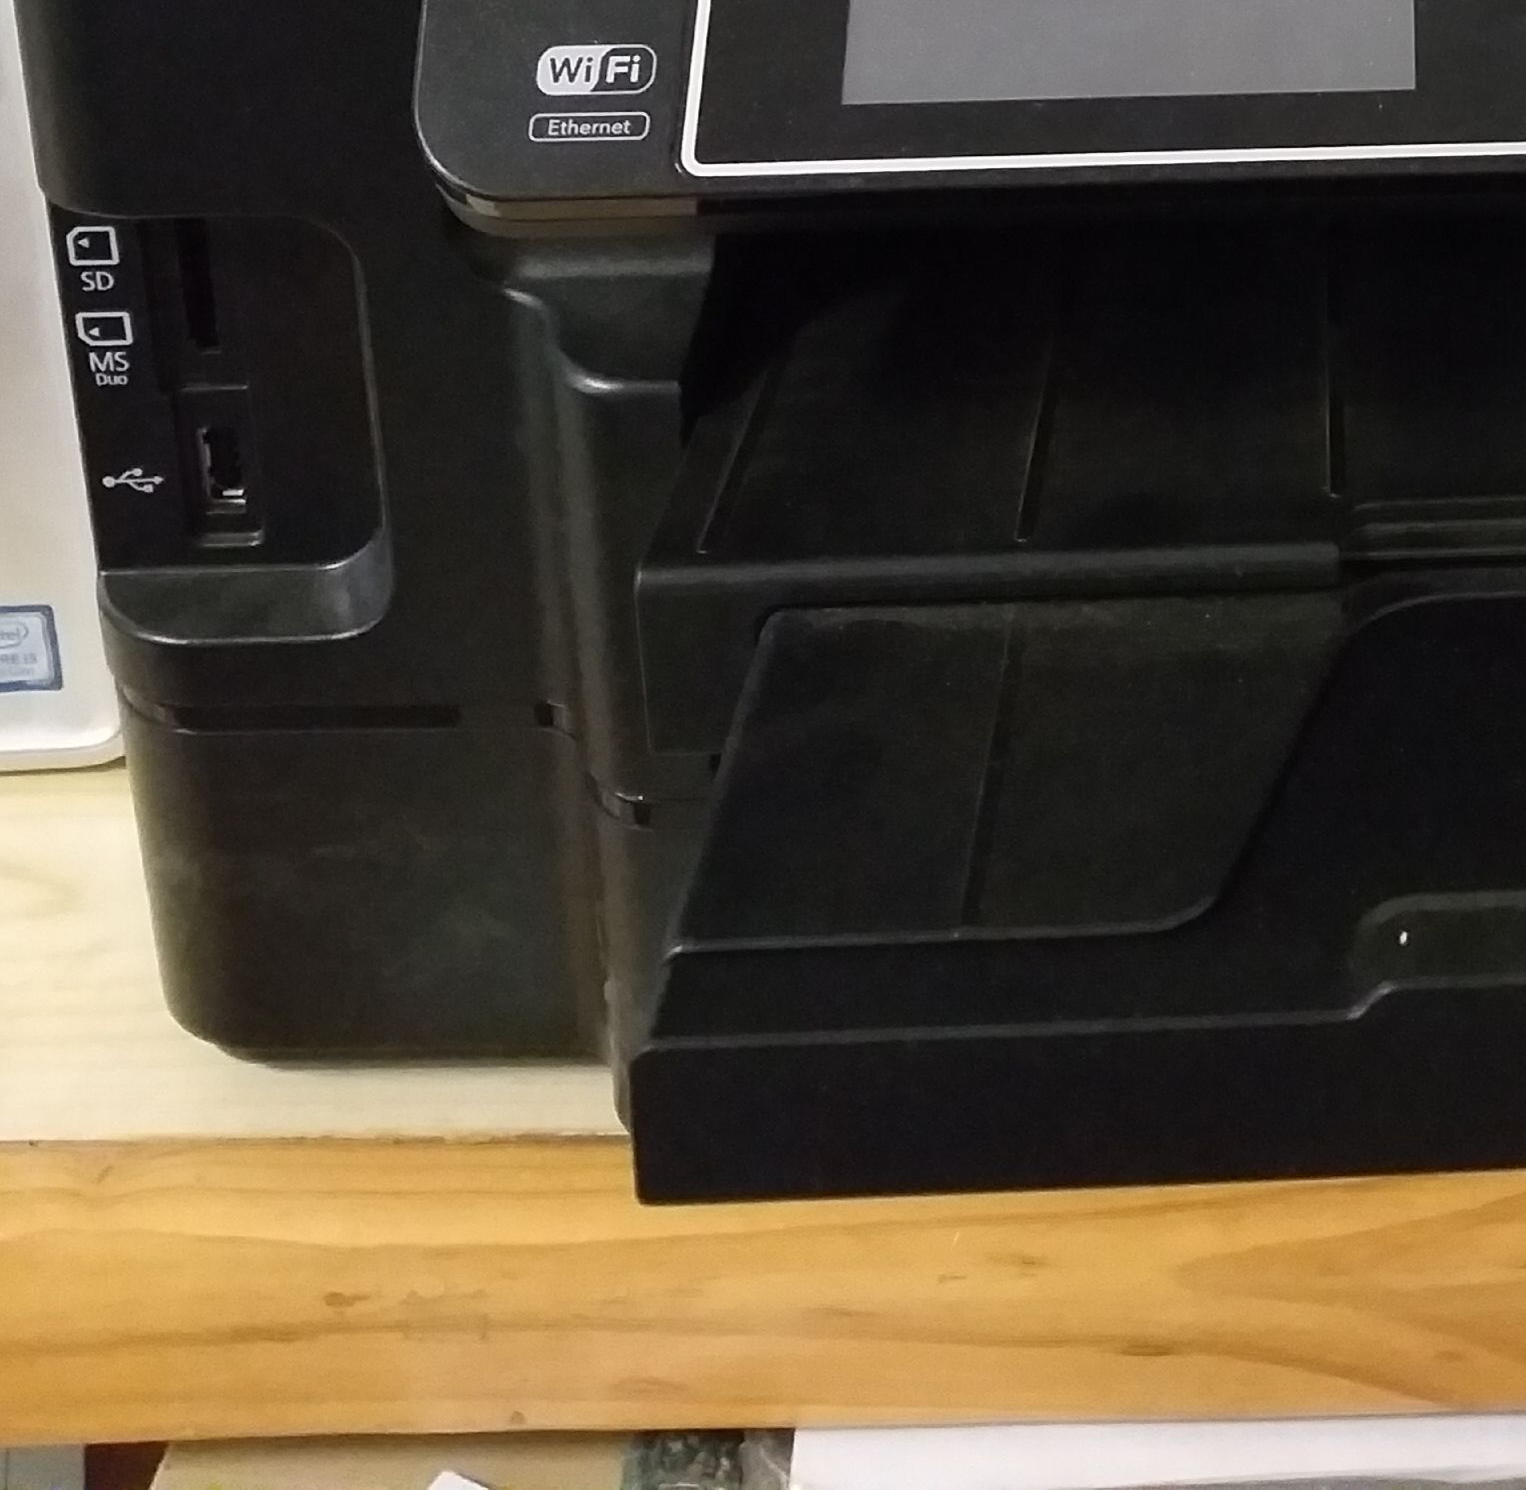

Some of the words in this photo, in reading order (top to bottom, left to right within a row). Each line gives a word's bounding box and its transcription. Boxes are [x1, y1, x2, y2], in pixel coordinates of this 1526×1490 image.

[547, 118, 631, 136] Ethernet
[80, 270, 115, 292] SD
[88, 351, 130, 372] MS
[95, 372, 129, 387] Duo
